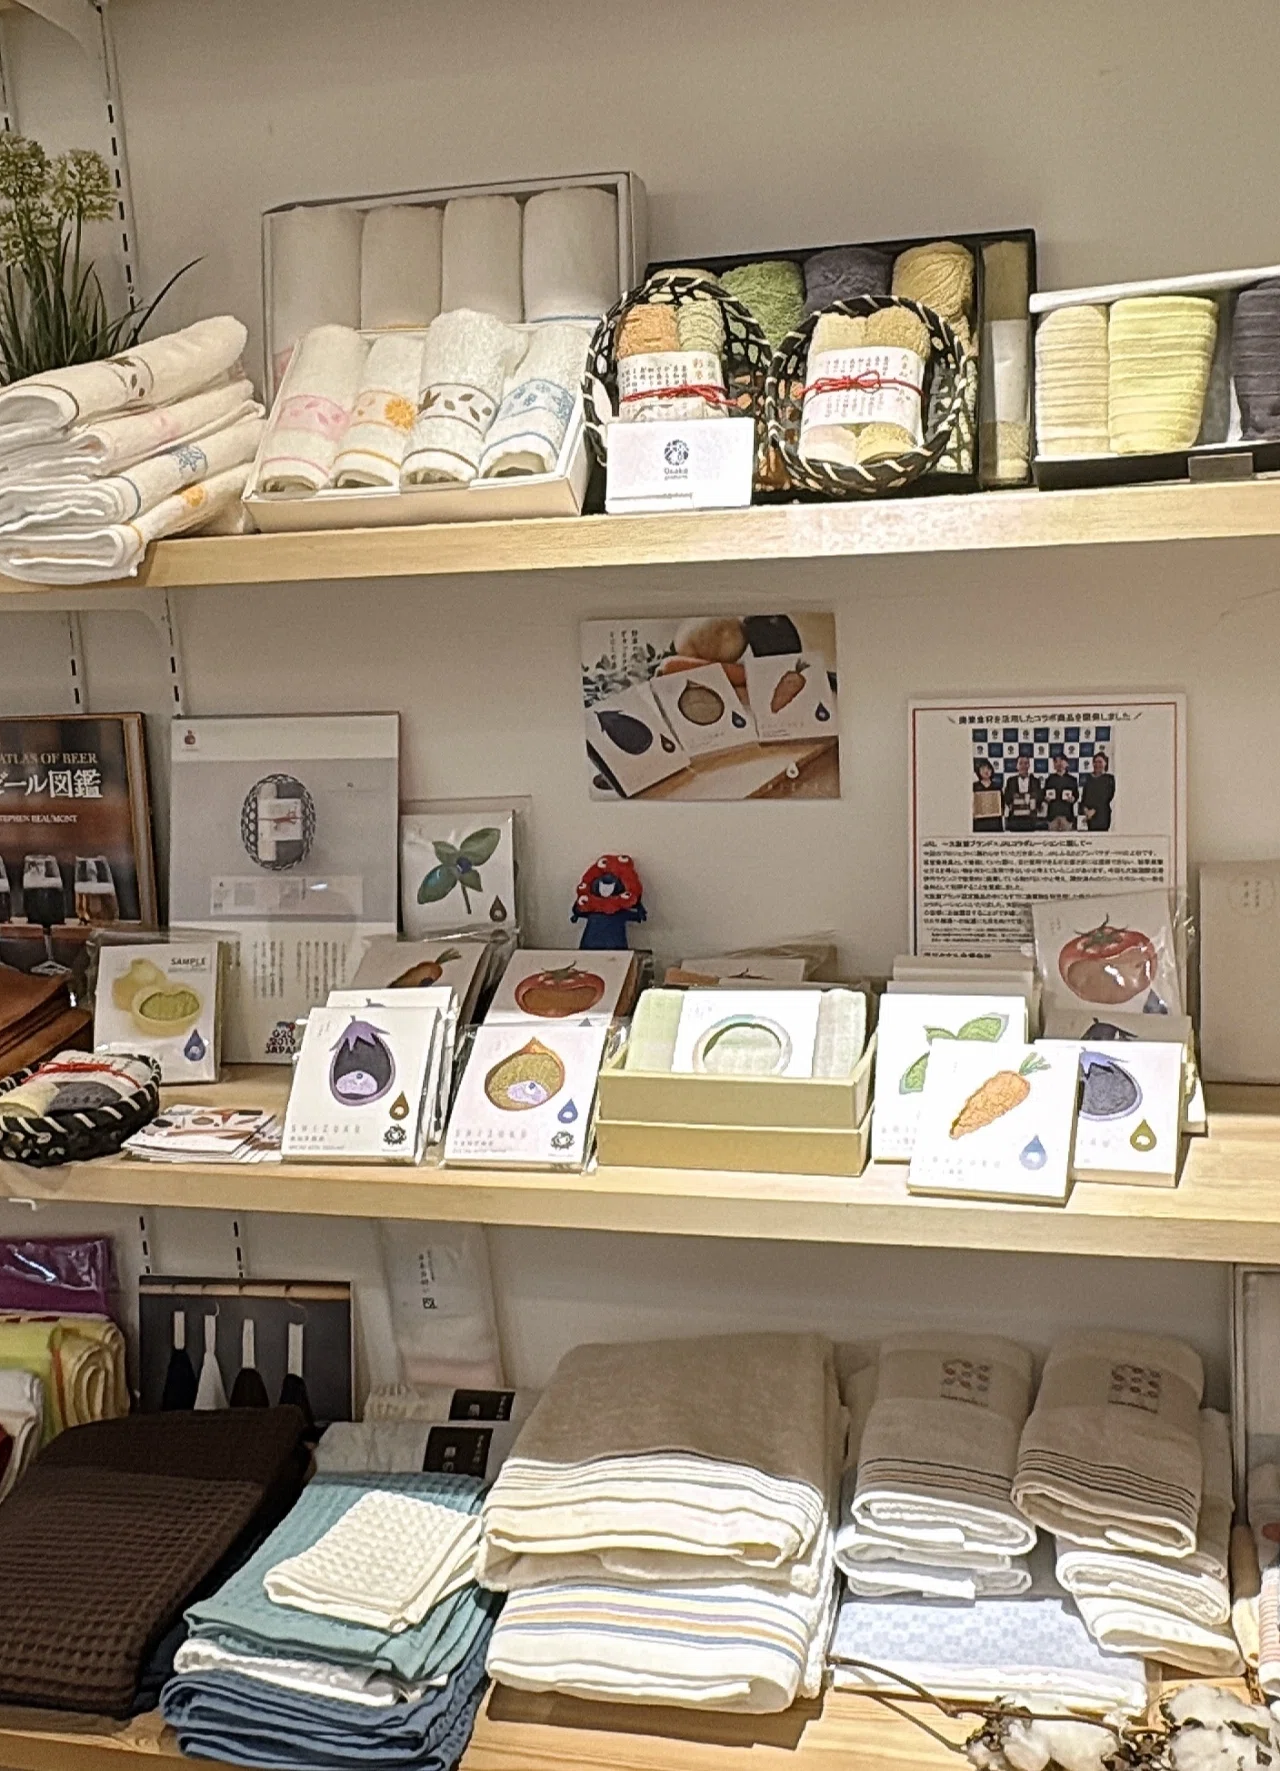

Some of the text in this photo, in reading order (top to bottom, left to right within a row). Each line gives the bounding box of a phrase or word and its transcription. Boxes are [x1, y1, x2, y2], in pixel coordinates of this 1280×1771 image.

[40, 753, 58, 765] OF
[62, 753, 98, 764] BEER
[171, 957, 206, 966] SAMPLE
